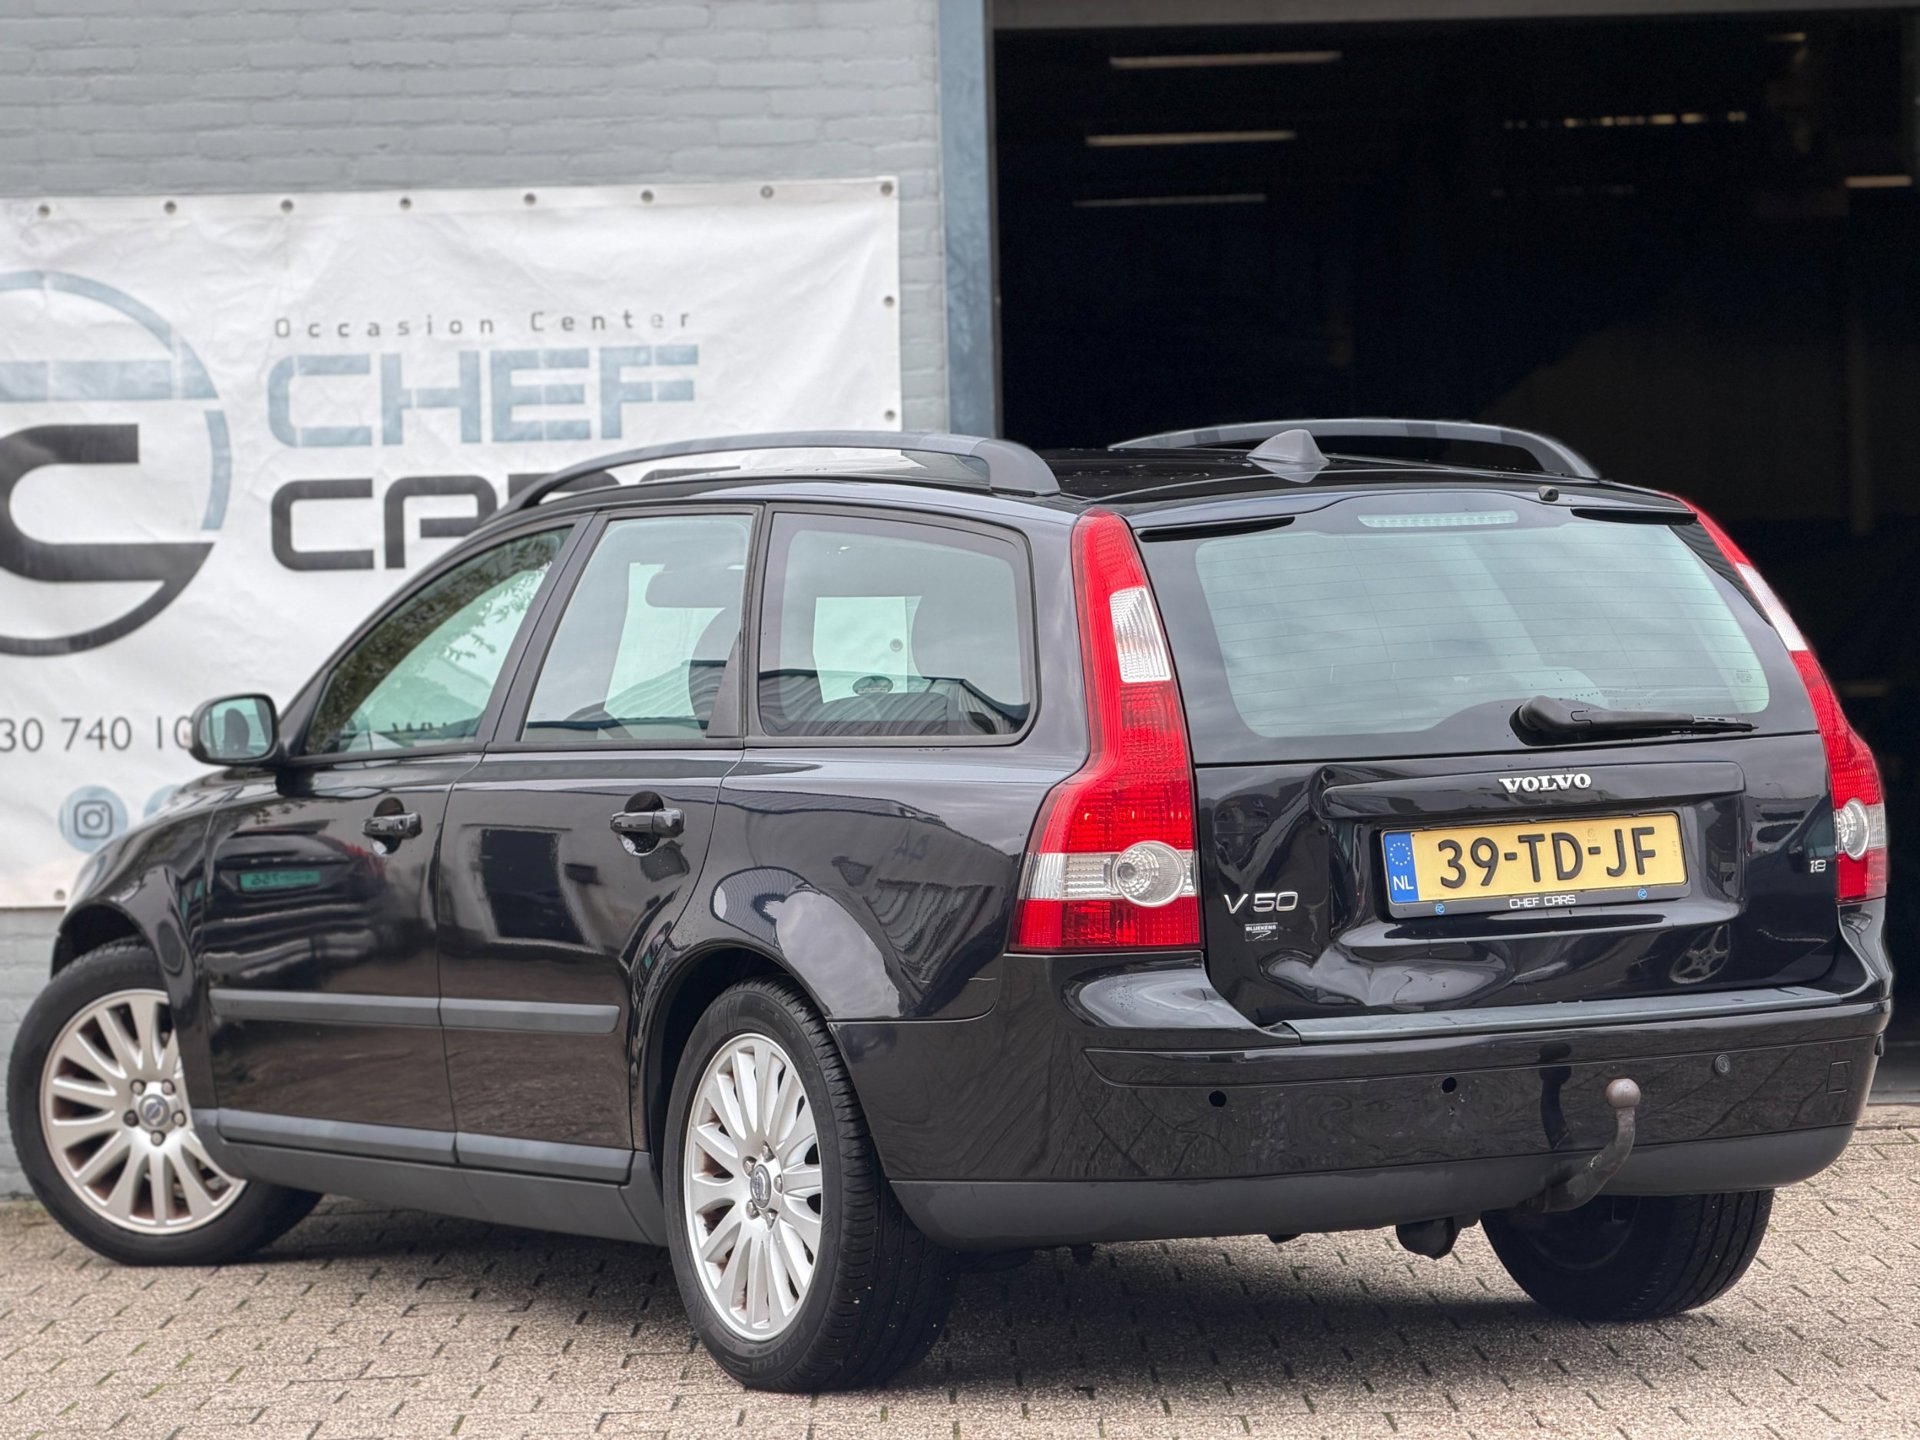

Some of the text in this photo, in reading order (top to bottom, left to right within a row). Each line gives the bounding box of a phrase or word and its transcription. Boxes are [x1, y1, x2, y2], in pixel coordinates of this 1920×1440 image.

[274, 309, 691, 338] Occasion Center
[267, 344, 699, 449] CHEF
[61, 716, 132, 752] 740
[1499, 773, 1592, 794] VOLVO
[1437, 826, 1657, 889] 39-TD-JF
[1393, 874, 1415, 891] NL
[1509, 894, 1577, 909] CHEF CARS
